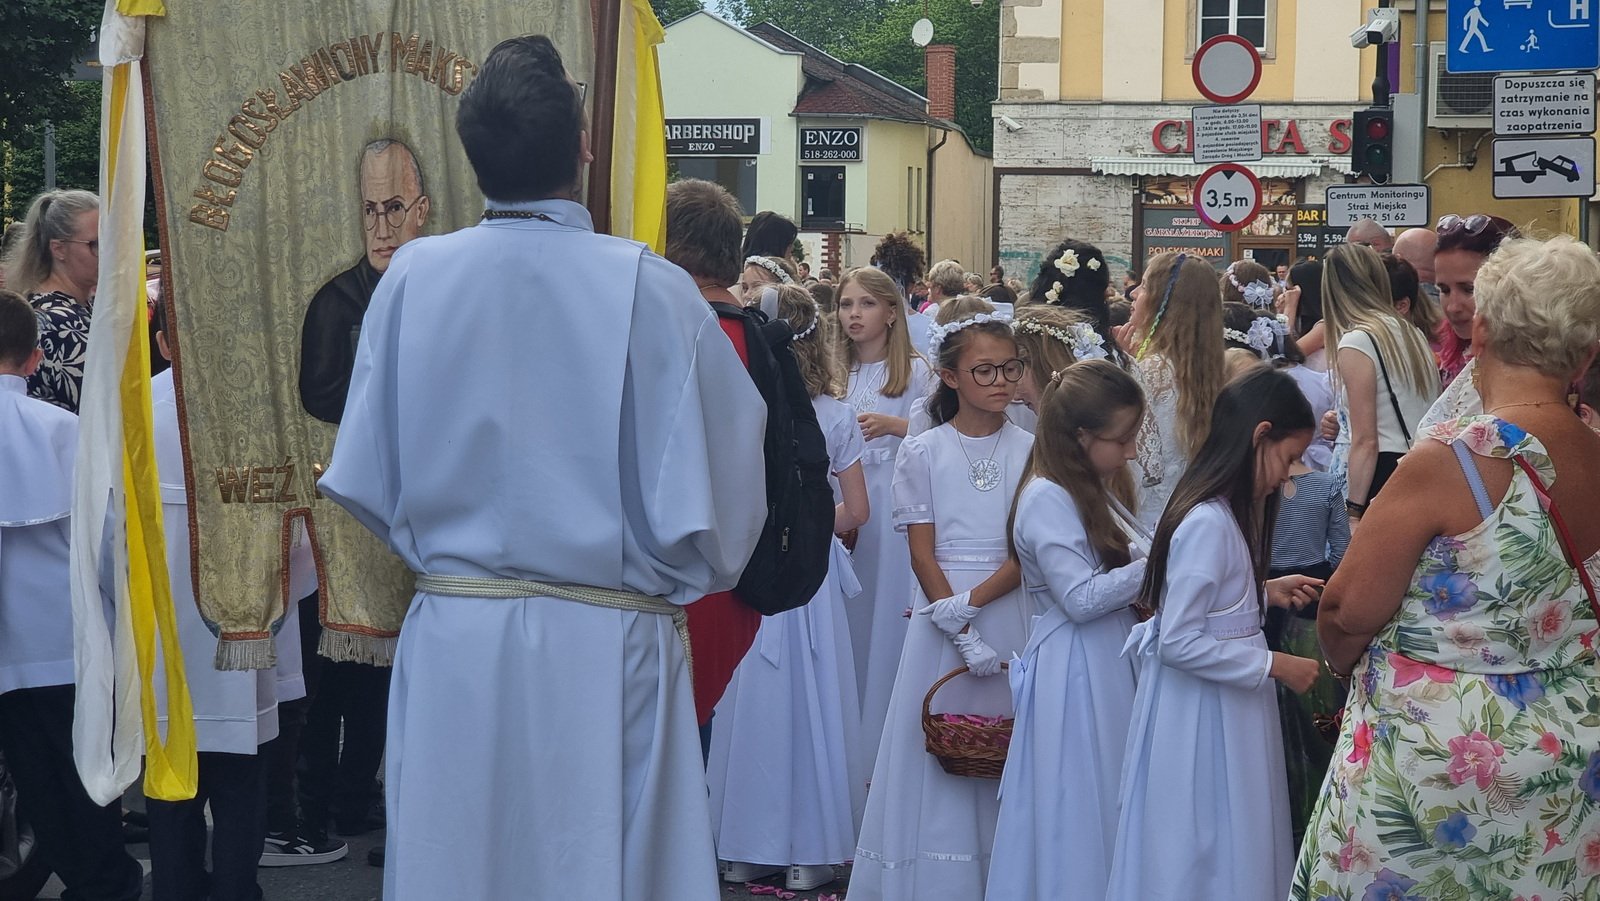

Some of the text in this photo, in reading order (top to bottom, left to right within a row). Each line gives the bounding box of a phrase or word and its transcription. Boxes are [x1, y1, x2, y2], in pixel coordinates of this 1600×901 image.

[1504, 77, 1586, 91] Dopuszcza się
[1501, 92, 1570, 105] zatrzymanie
[1500, 106, 1590, 119] czas wykonania
[189, 31, 479, 232] BŁOGOSŁAWIONY MAKS
[1507, 120, 1583, 133] zaopatrzenia
[664, 124, 755, 144] ARBERSHOP
[804, 130, 859, 146] ENZO
[688, 142, 715, 151] ENZO
[804, 150, 857, 159] 518-262-000
[1329, 190, 1425, 202] Centrum Monitoringu
[1347, 202, 1407, 212] Straż Miejska
[1172, 217, 1202, 226] SKLEP
[1297, 210, 1319, 221] BAR
[1348, 214, 1358, 222] 75
[1381, 213, 1391, 221] 51
[1394, 212, 1406, 221] 62
[215, 455, 298, 503] WEŹ
